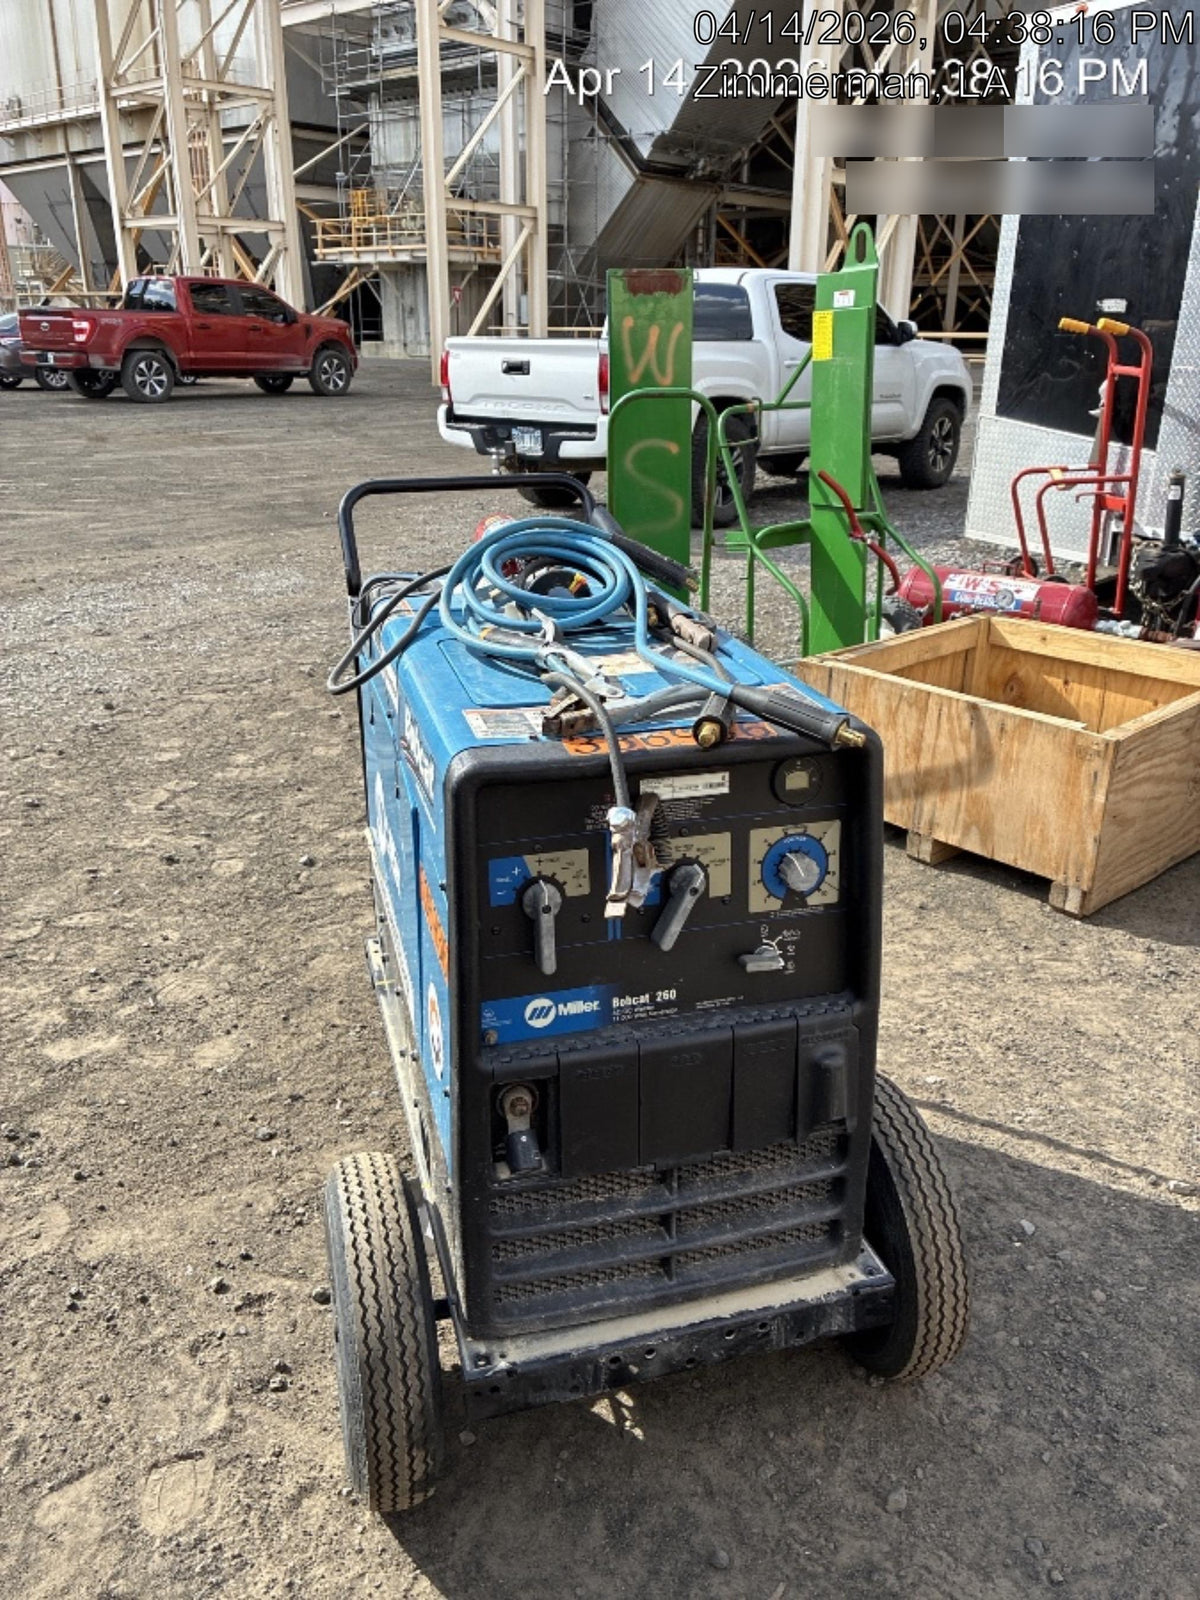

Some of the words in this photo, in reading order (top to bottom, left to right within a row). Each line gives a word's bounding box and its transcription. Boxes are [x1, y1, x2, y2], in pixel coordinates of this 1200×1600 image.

[621, 315, 684, 386] W
[624, 437, 684, 536] S
[557, 999, 601, 1017] Miller
[611, 993, 651, 1009] Bobcat
[655, 988, 678, 1003] 260
